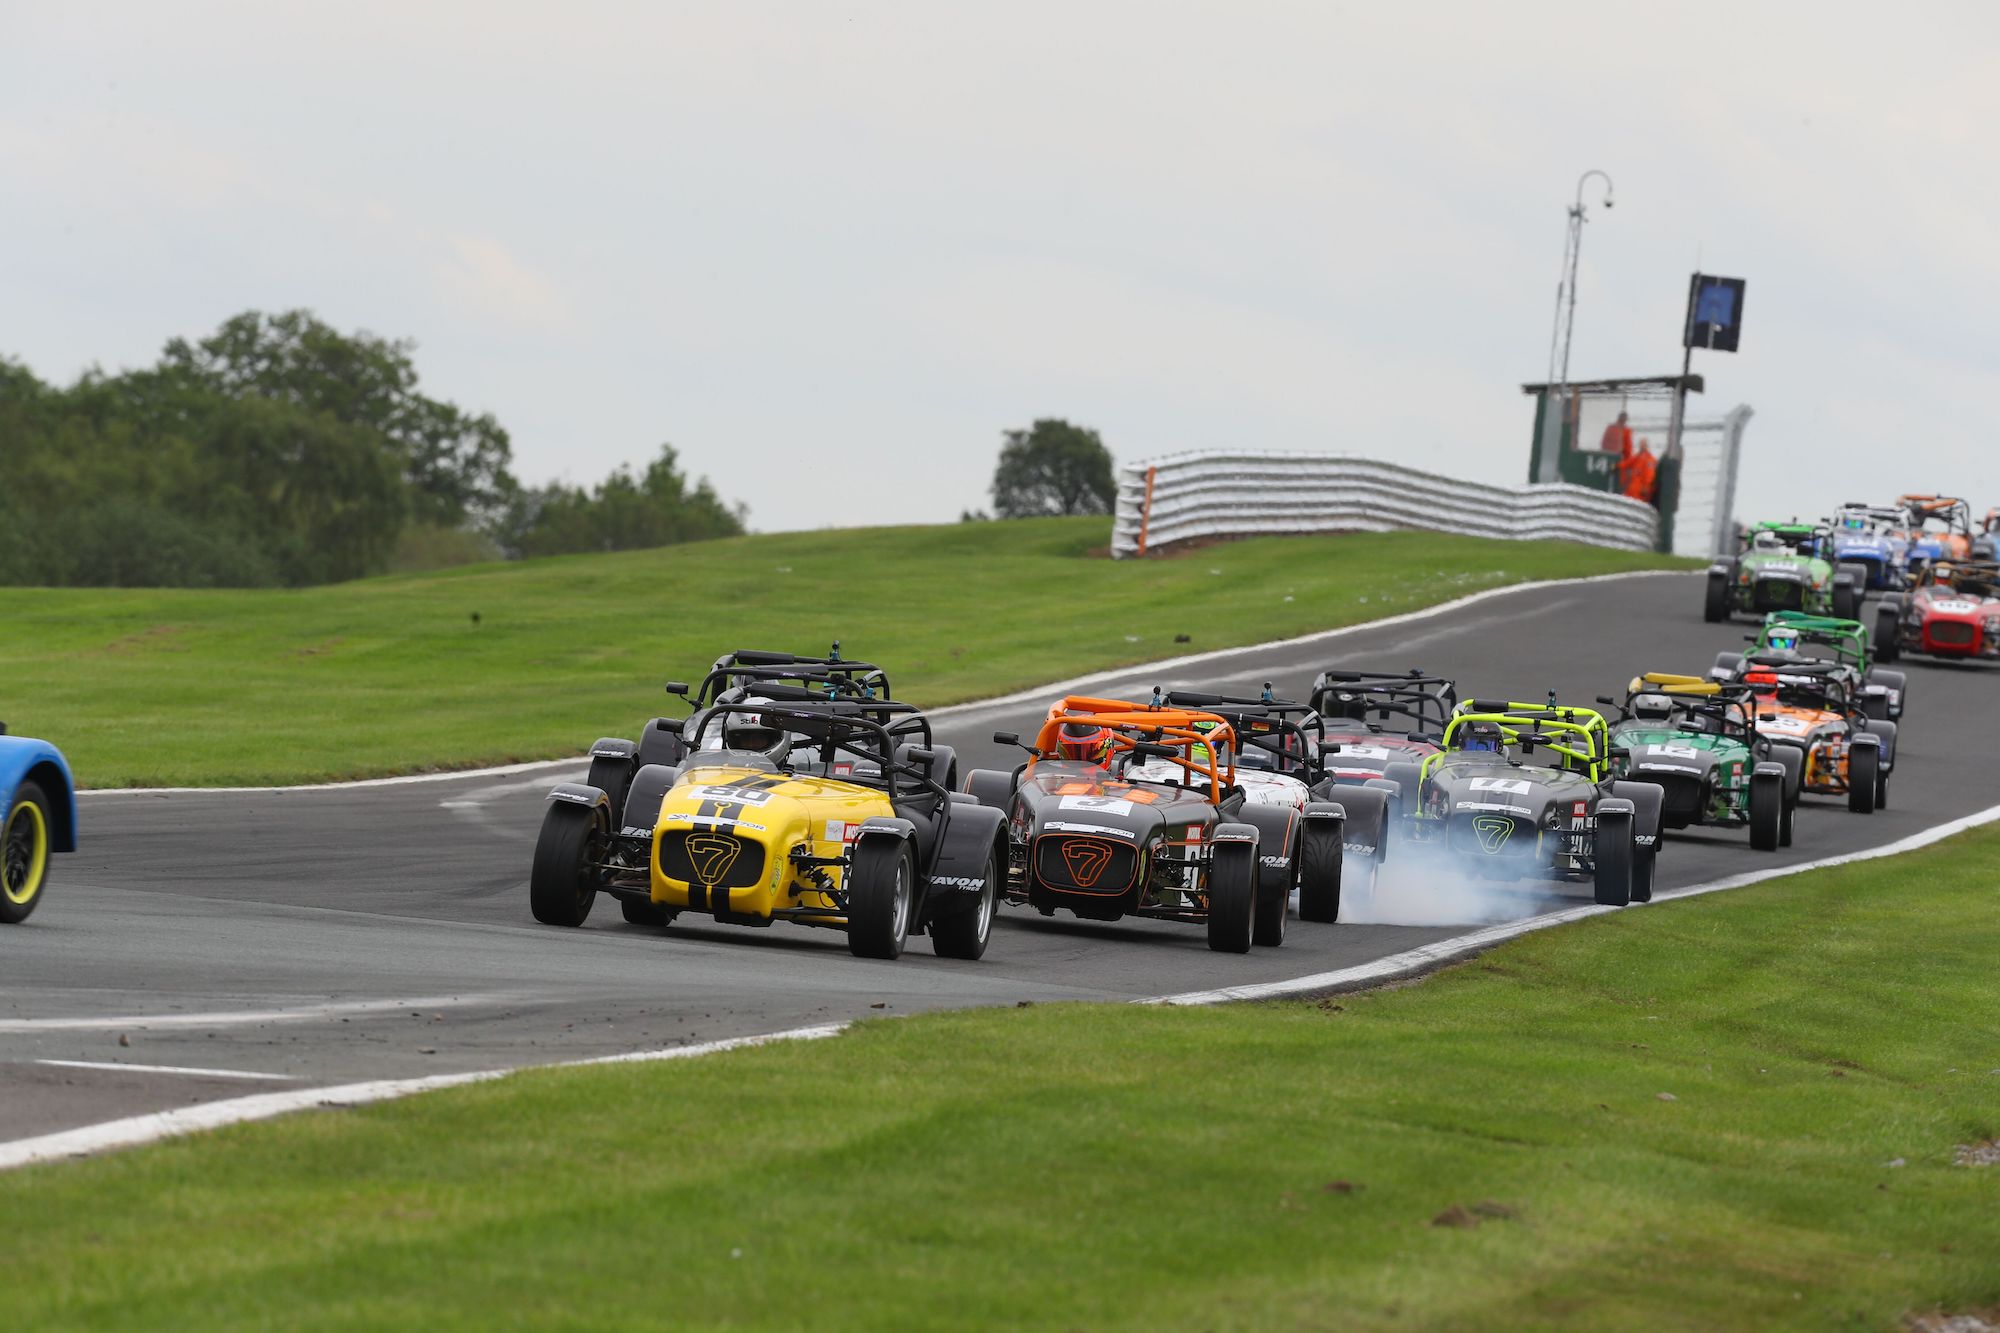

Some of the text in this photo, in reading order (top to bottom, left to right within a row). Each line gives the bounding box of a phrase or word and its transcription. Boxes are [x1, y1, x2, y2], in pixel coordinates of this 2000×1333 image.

[1586, 455, 1608, 476] 14
[702, 785, 773, 802] 80
[731, 821, 765, 830] 270R
[1103, 828, 1133, 837] 270R
[1477, 819, 1510, 849] 7
[692, 839, 734, 878] 7
[1068, 844, 1106, 880] 7
[932, 876, 986, 888] AVON
